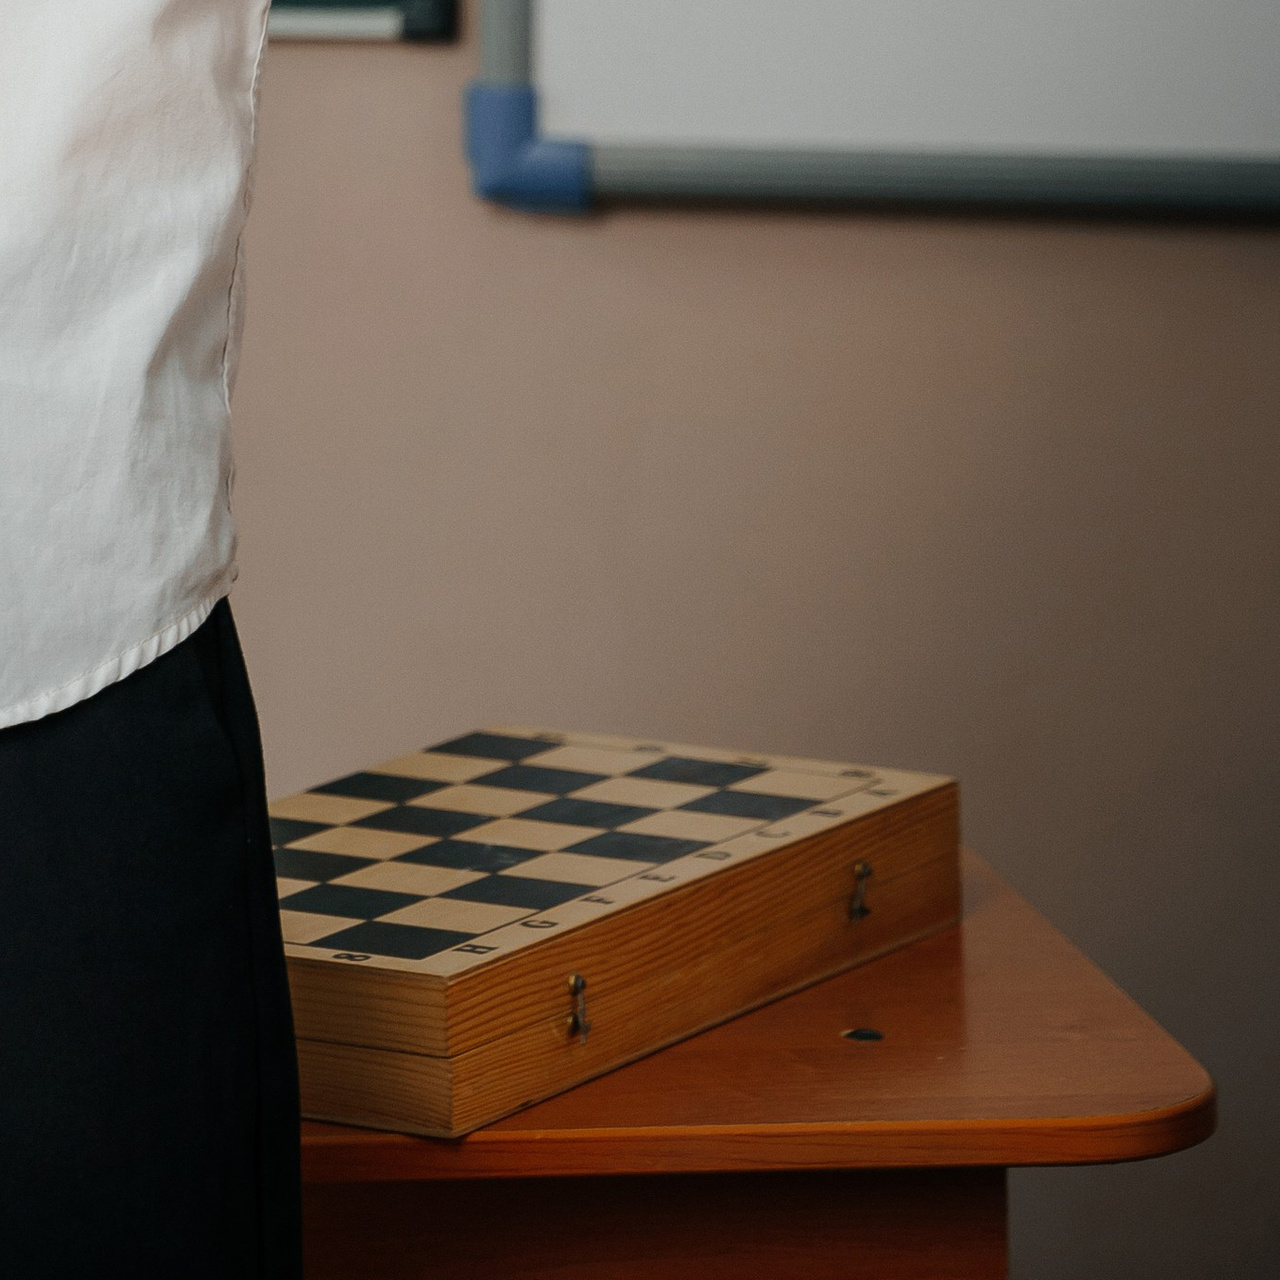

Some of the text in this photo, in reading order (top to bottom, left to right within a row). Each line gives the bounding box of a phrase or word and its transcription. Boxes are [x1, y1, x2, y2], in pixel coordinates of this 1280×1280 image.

[694, 849, 732, 861] D
[638, 873, 678, 883] E
[581, 895, 615, 905] F
[520, 918, 559, 929] G
[452, 944, 499, 955] H
[332, 953, 372, 962] 8
